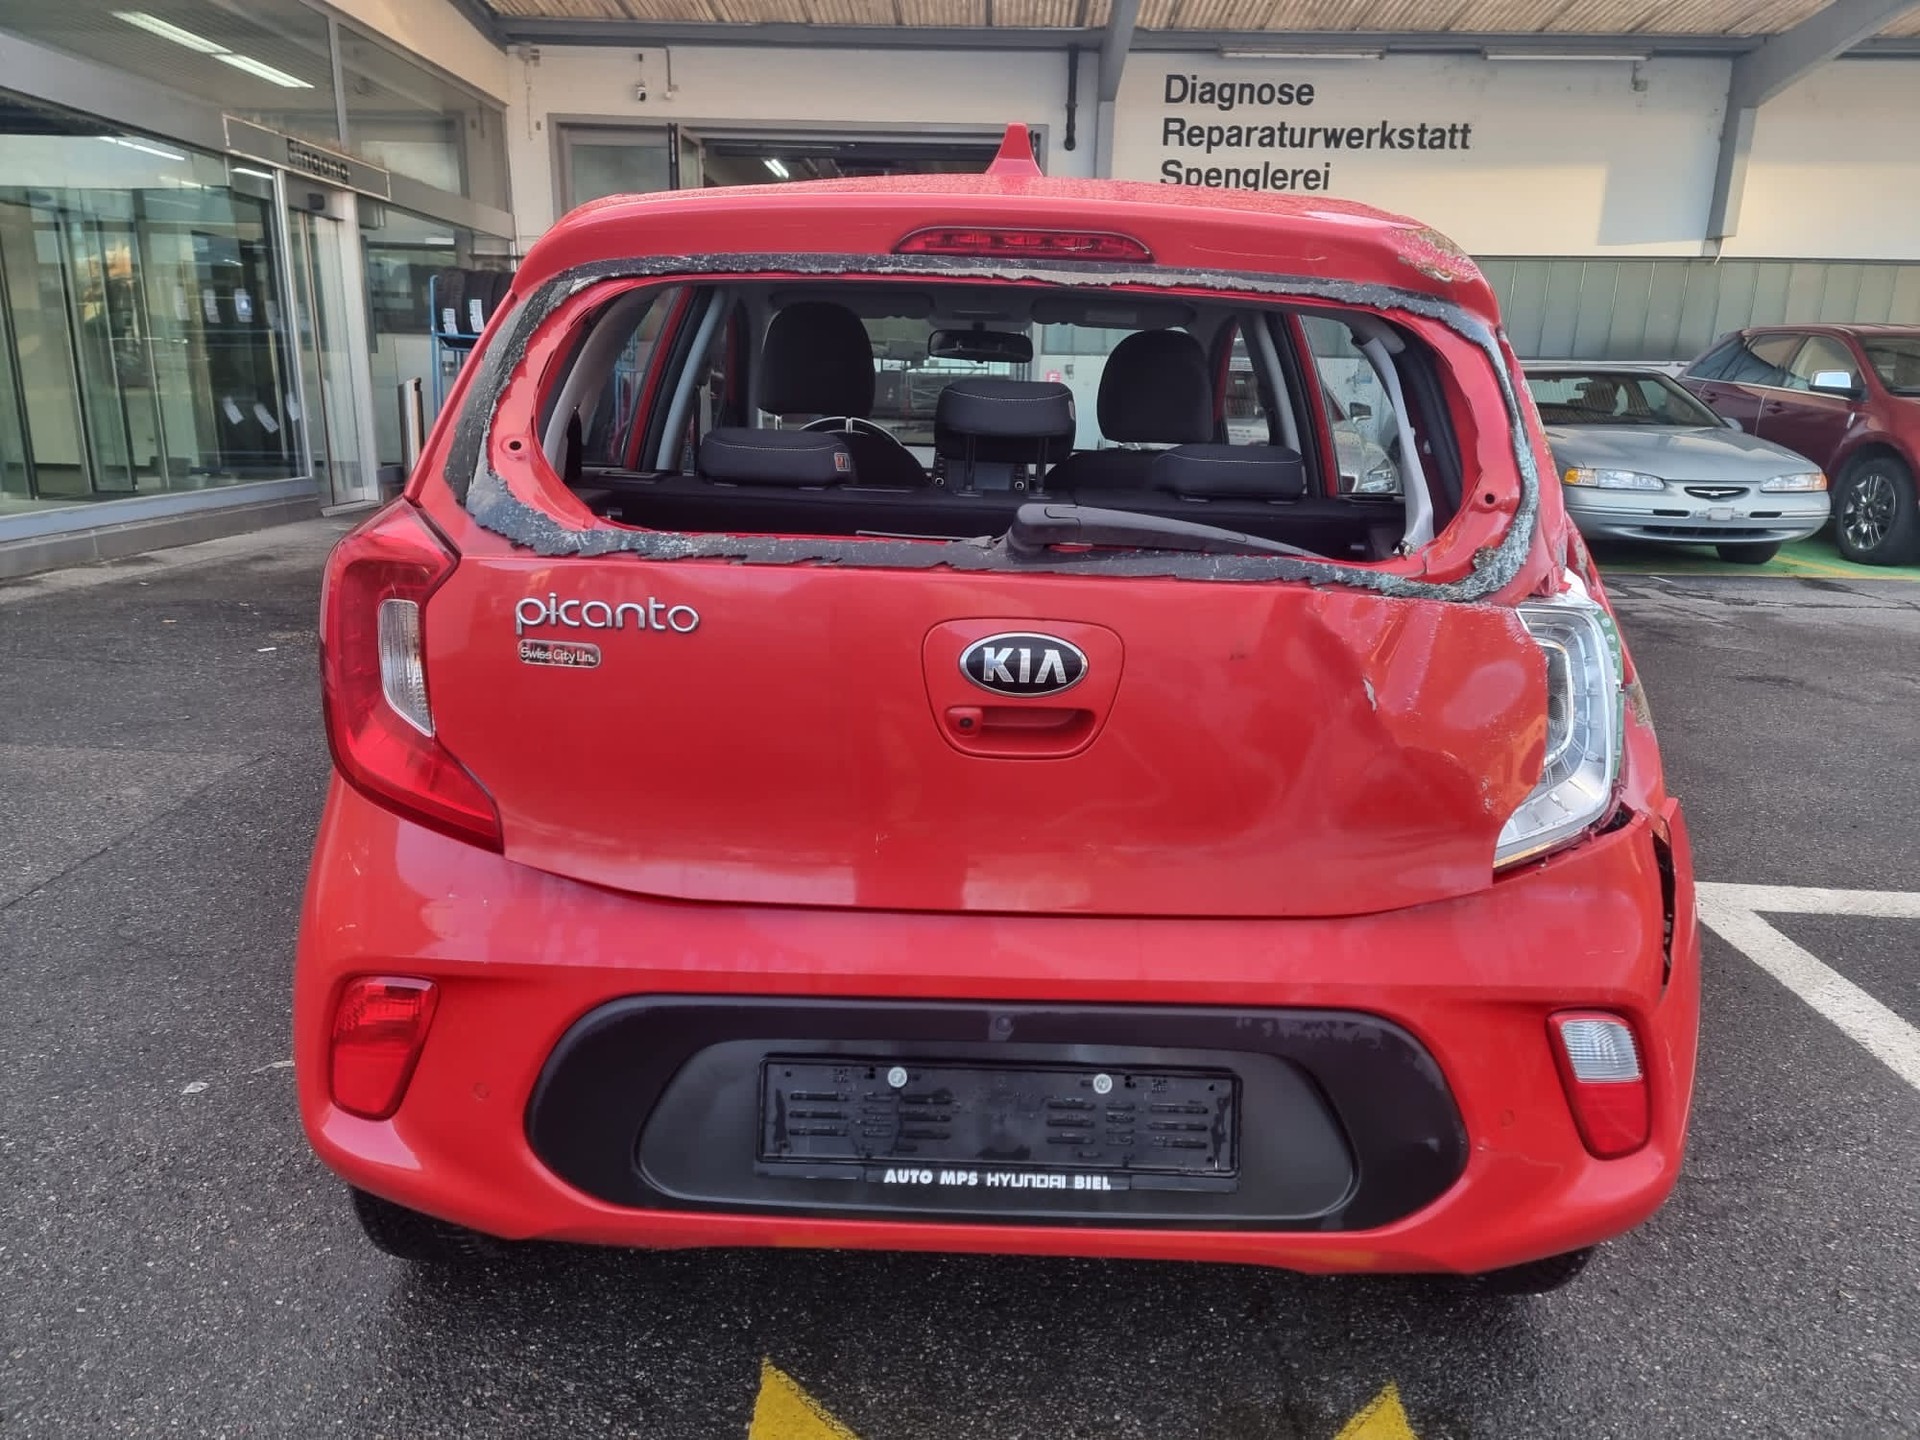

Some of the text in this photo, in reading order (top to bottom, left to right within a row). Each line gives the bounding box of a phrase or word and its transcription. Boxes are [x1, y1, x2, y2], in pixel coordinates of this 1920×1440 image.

[1164, 74, 1315, 111] Diagnose
[1162, 117, 1472, 154] Reparaturwerkstatt
[286, 137, 350, 185] Eingang
[1160, 159, 1331, 191] Spenglerei
[515, 592, 700, 636] picanto
[520, 646, 553, 660] Swiss
[553, 648, 576, 664] City
[982, 646, 1068, 684] KIA
[883, 1168, 1112, 1190] AUTO MPS HYUNDAI BIEL
